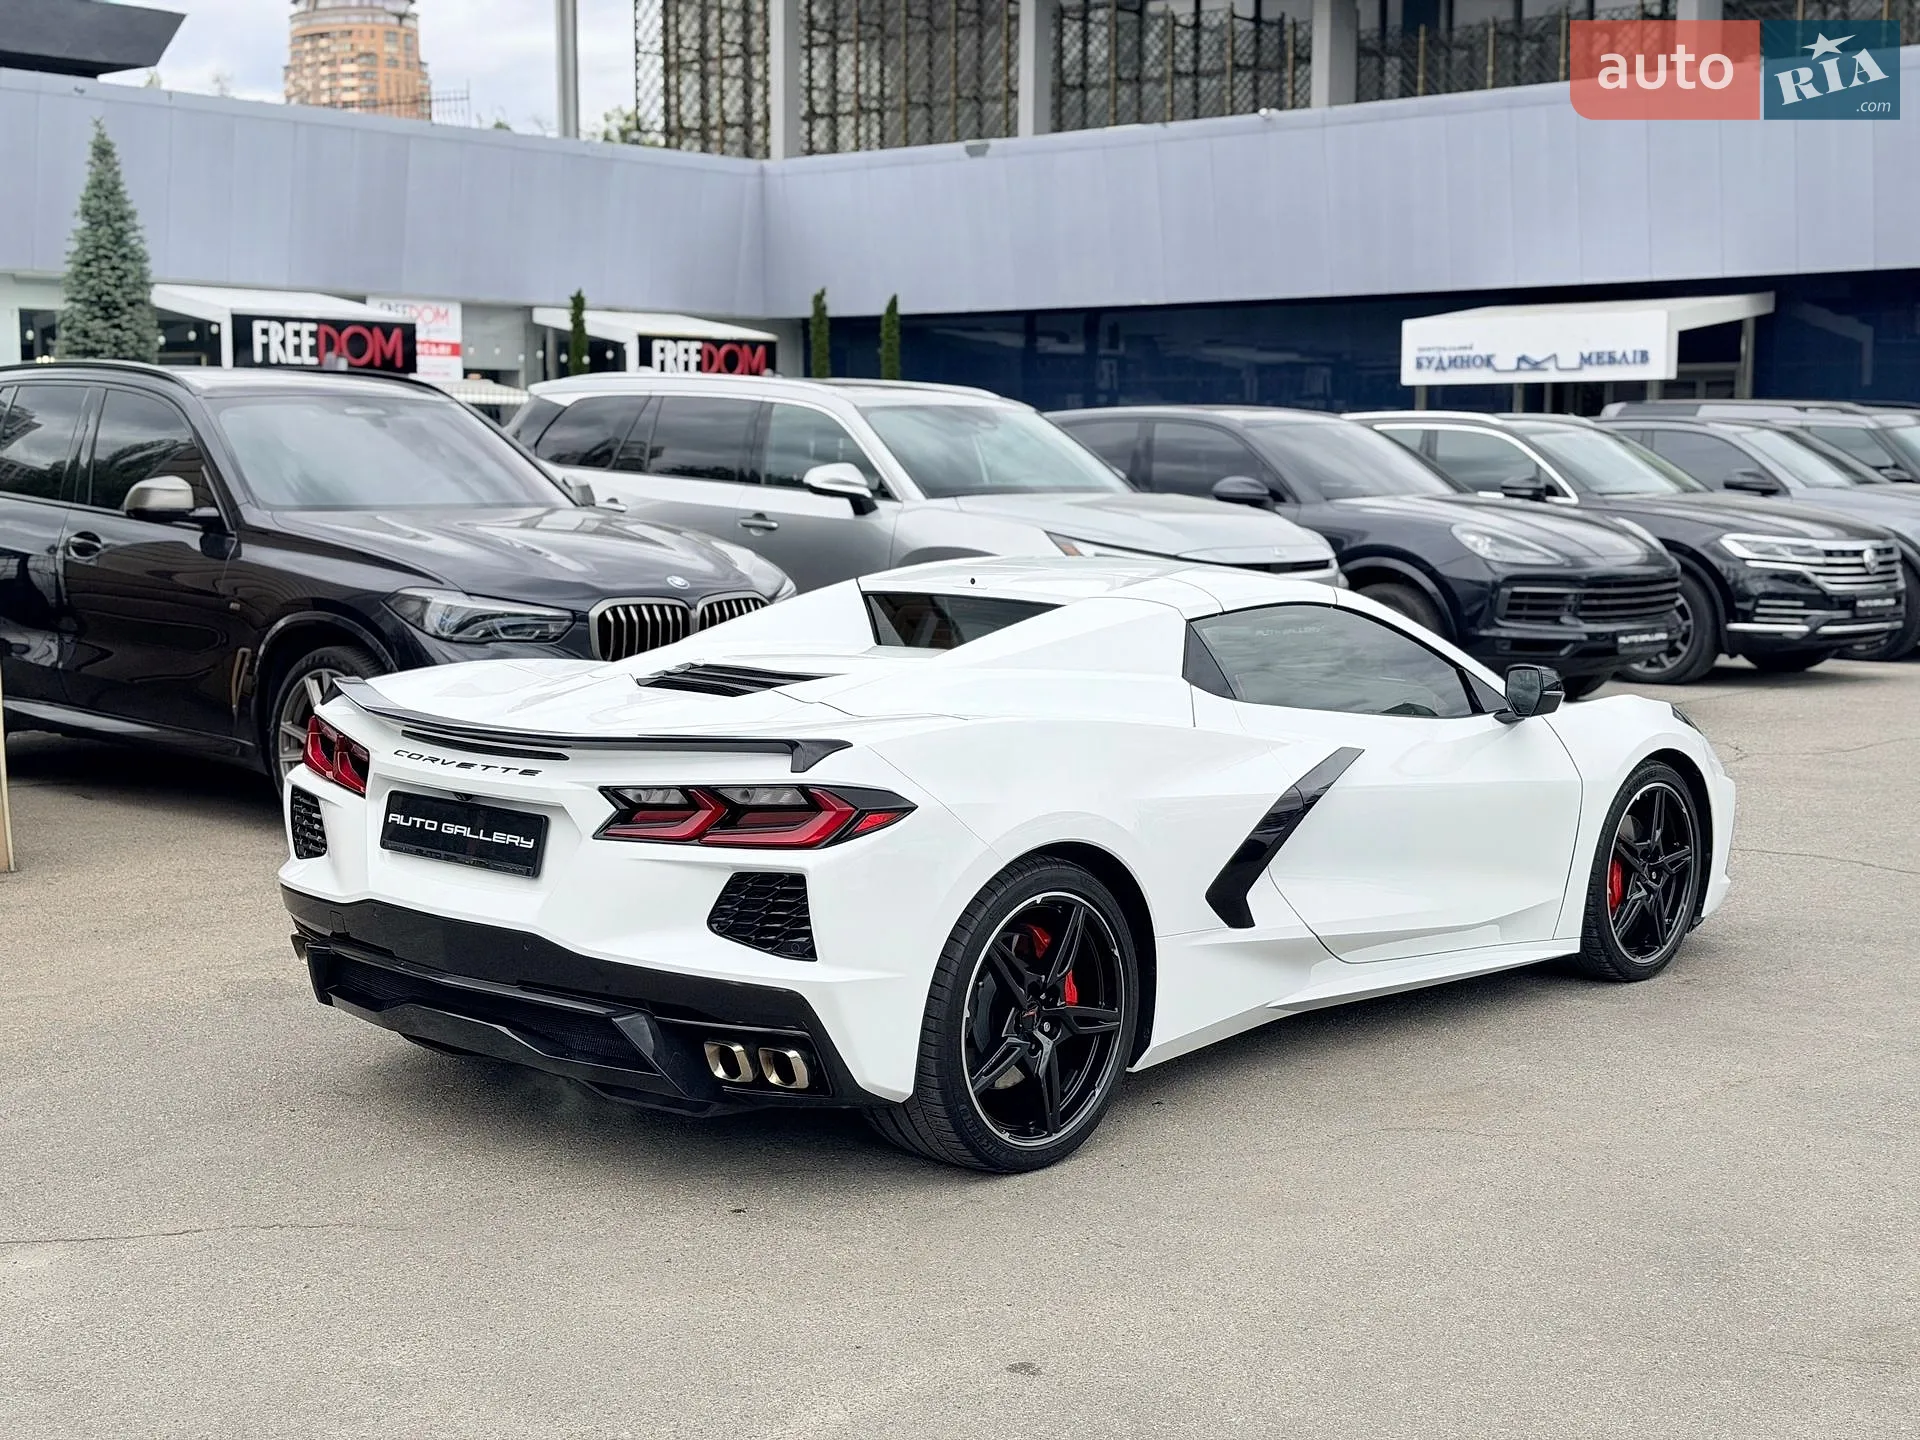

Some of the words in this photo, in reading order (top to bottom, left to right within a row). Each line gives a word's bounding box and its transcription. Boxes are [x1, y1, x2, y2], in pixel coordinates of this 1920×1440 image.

[252, 320, 404, 368] FREEDOM
[652, 339, 766, 375] FREEDOM
[1416, 354, 1495, 371] БУДИНОК
[1580, 350, 1649, 365] МЕБЛІВ
[393, 749, 543, 777] CORVETTE
[388, 813, 437, 831] AUTO
[441, 823, 534, 849] GALLERY
